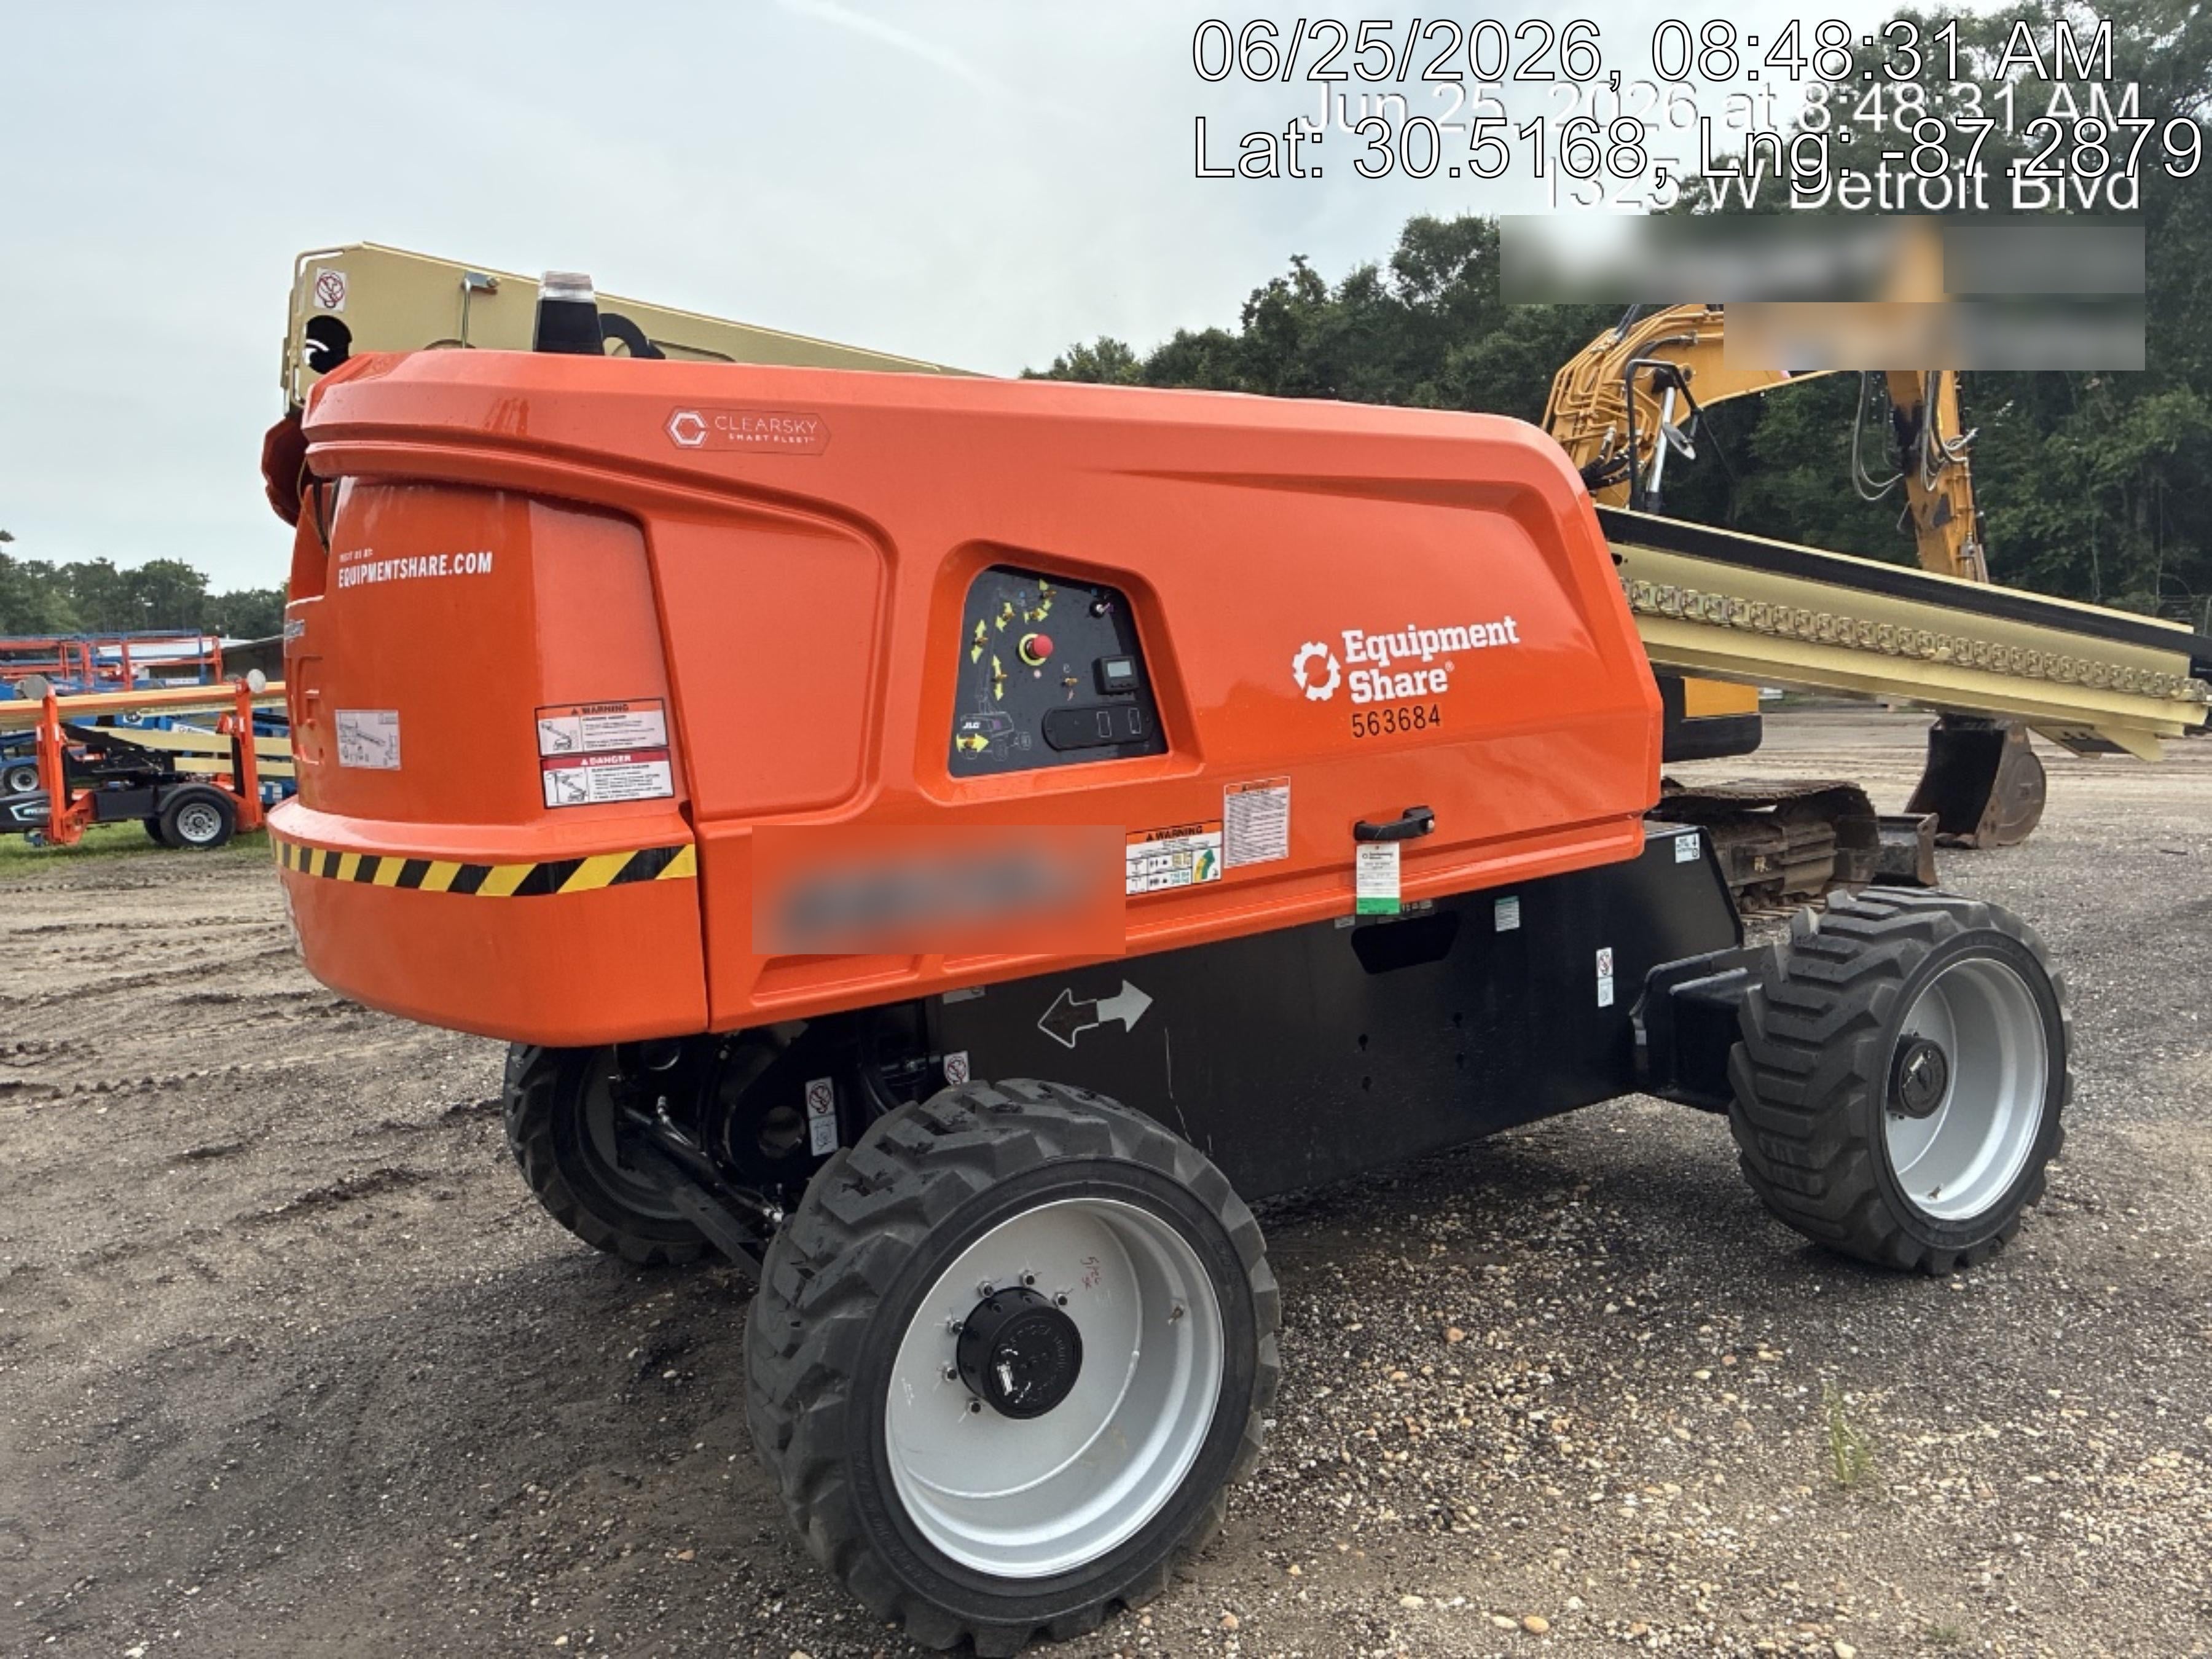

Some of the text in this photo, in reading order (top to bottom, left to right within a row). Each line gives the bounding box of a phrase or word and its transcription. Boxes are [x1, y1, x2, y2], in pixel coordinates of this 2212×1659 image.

[715, 416, 817, 434] CLEARSKY
[338, 551, 493, 589] EQUIPMENTSHARE.COM
[1342, 615, 1520, 667] Equipment
[581, 704, 629, 714] WARNING
[1352, 704, 1441, 738] 563684
[589, 755, 632, 766] DANGER
[1155, 825, 1204, 841] WARNING
